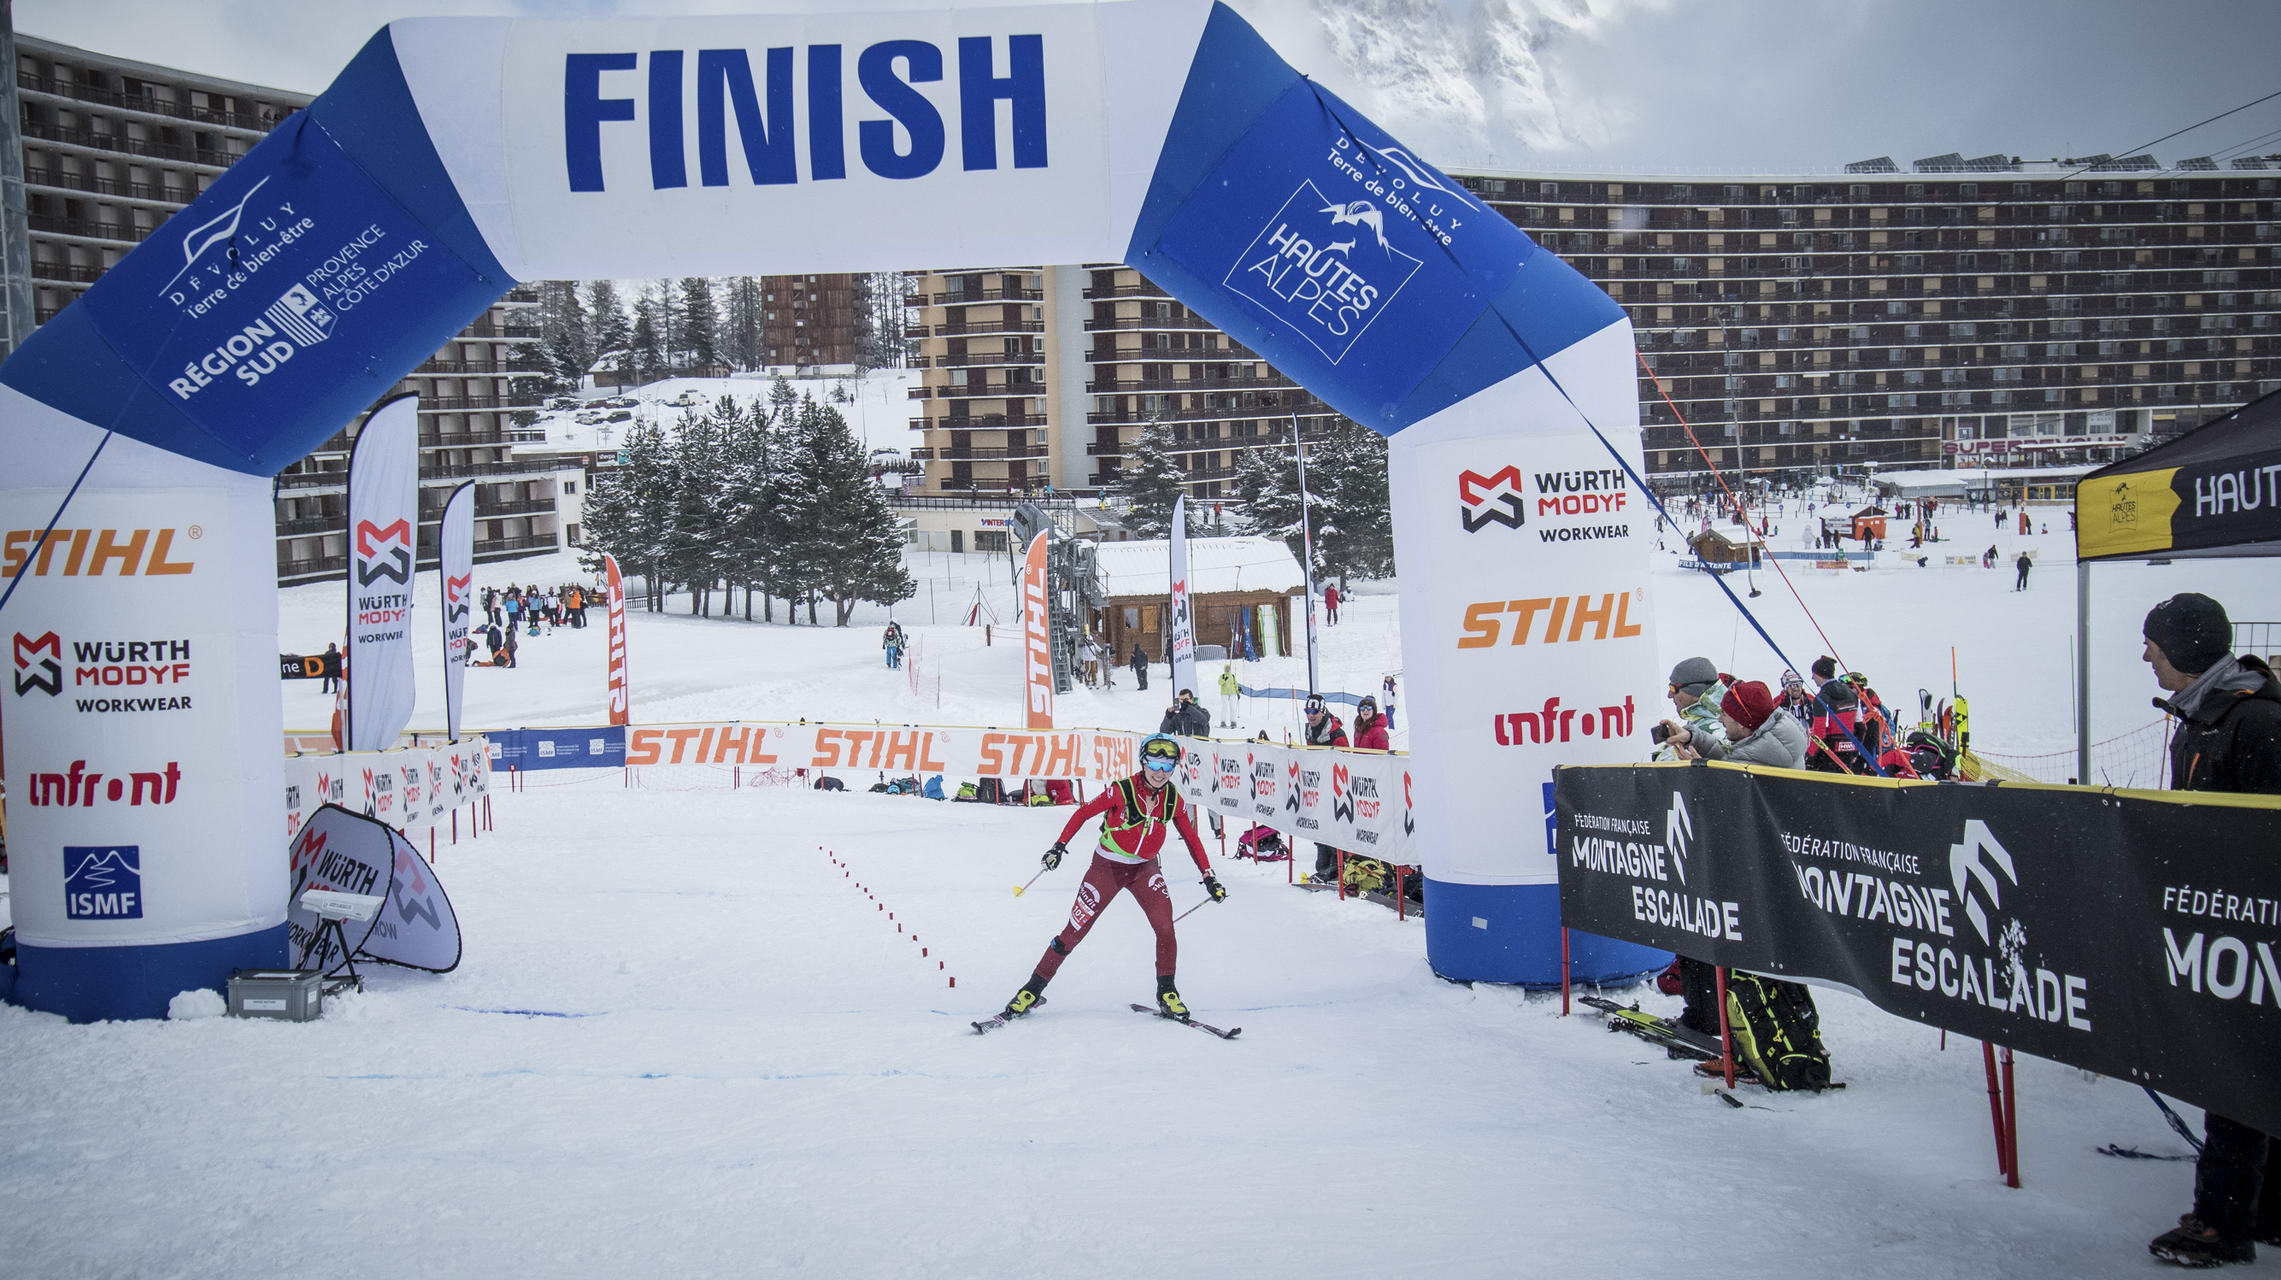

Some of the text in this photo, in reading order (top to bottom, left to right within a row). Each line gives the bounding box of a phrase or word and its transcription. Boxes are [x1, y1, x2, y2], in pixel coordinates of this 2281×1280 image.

[565, 34, 1048, 193] FINISH
[1328, 148, 1363, 182] Terre
[1365, 177, 1384, 197] de
[182, 288, 228, 319] Terre
[242, 217, 315, 273] bien-être
[306, 223, 386, 287] PROVENCE
[337, 239, 429, 312] CÔTE D'AZUR
[1268, 223, 1378, 310] HAUTES
[322, 262, 367, 300] ALPES
[1247, 253, 1360, 336] ALPES
[168, 318, 276, 400] RÉGION
[235, 340, 295, 386] SUD
[1535, 469, 1626, 493] WÜRTH
[2195, 464, 2281, 517] HAUT
[1537, 492, 1627, 517] MODYF
[2112, 501, 2136, 513] HAUTES
[2112, 511, 2136, 524] ALPES
[2, 528, 195, 578] STIHL
[1539, 525, 1630, 543] WORKWEAR
[1027, 567, 1052, 716] STIHL
[1457, 591, 1642, 649] STIHL
[73, 639, 190, 663] WÜRTH
[75, 663, 190, 686] MODYF
[75, 695, 192, 713] WORKWEAR
[626, 727, 778, 766] STIHL
[811, 728, 945, 772] STIHL
[976, 732, 1086, 777] STIHL
[1574, 812, 1651, 836] FÉDÉRATION FRANÇAISE
[1572, 835, 1668, 882] MONTAGNE
[1860, 847, 1921, 875] FRANÇAISE
[70, 892, 136, 916] ISMF
[1073, 905, 1086, 921] 101
[1631, 885, 1743, 942] ESCALADE
[2163, 884, 2279, 926] FÉDÉRATI
[1892, 937, 2092, 1032] ESCALADE
[2163, 927, 2281, 1009] MON
